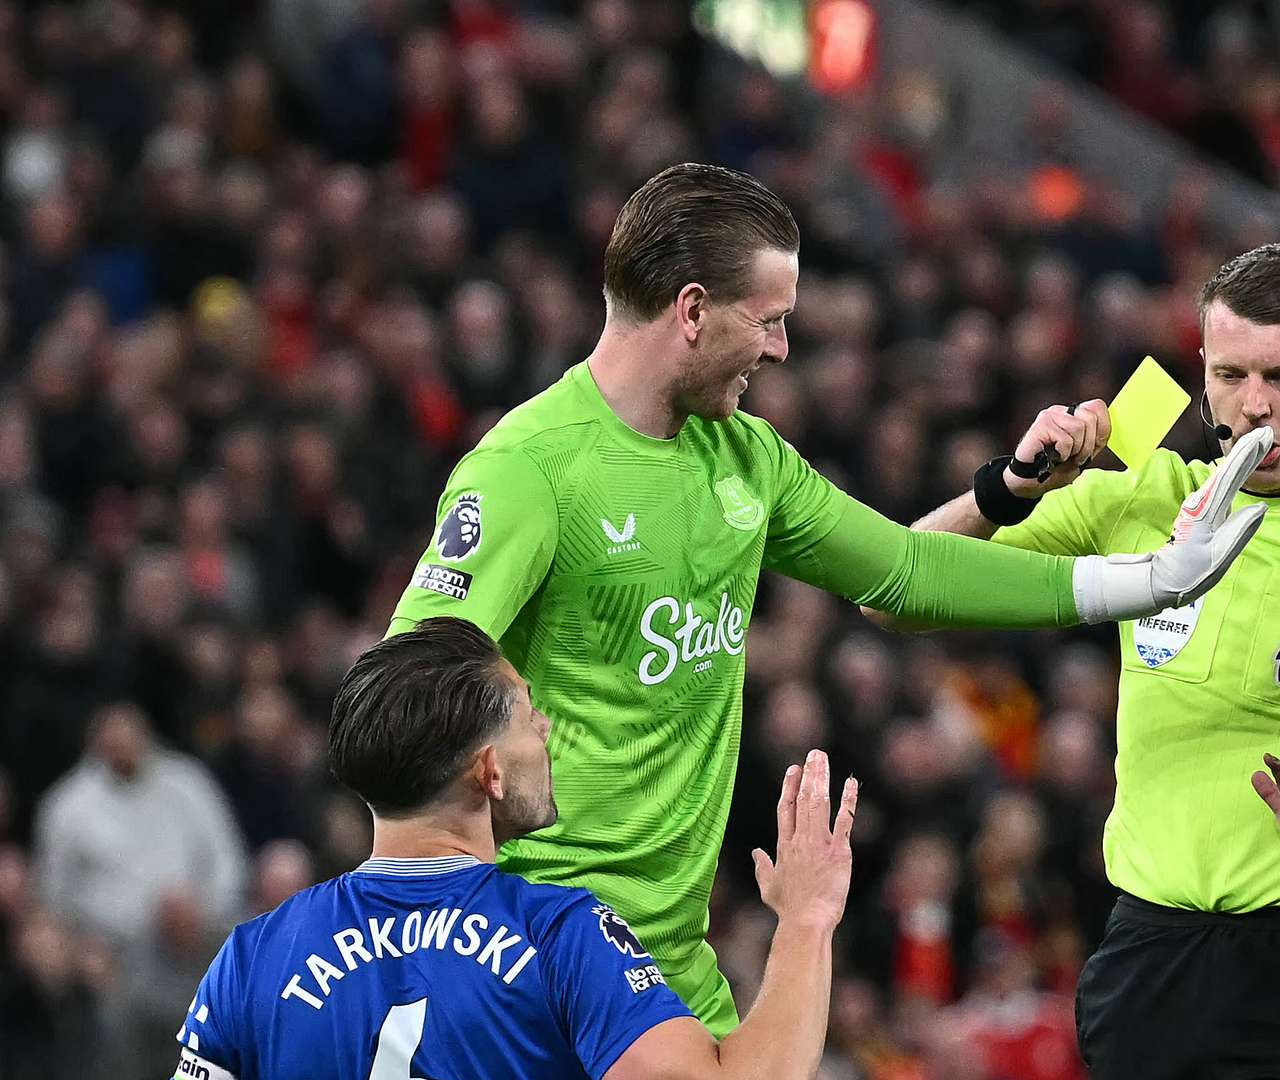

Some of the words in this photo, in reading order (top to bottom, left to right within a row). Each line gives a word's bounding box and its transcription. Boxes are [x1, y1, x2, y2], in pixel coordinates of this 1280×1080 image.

[607, 541, 641, 556] CASTORE
[638, 592, 745, 686] Stake
[693, 659, 713, 674] .com
[281, 907, 538, 1011] TARKOWSKI
